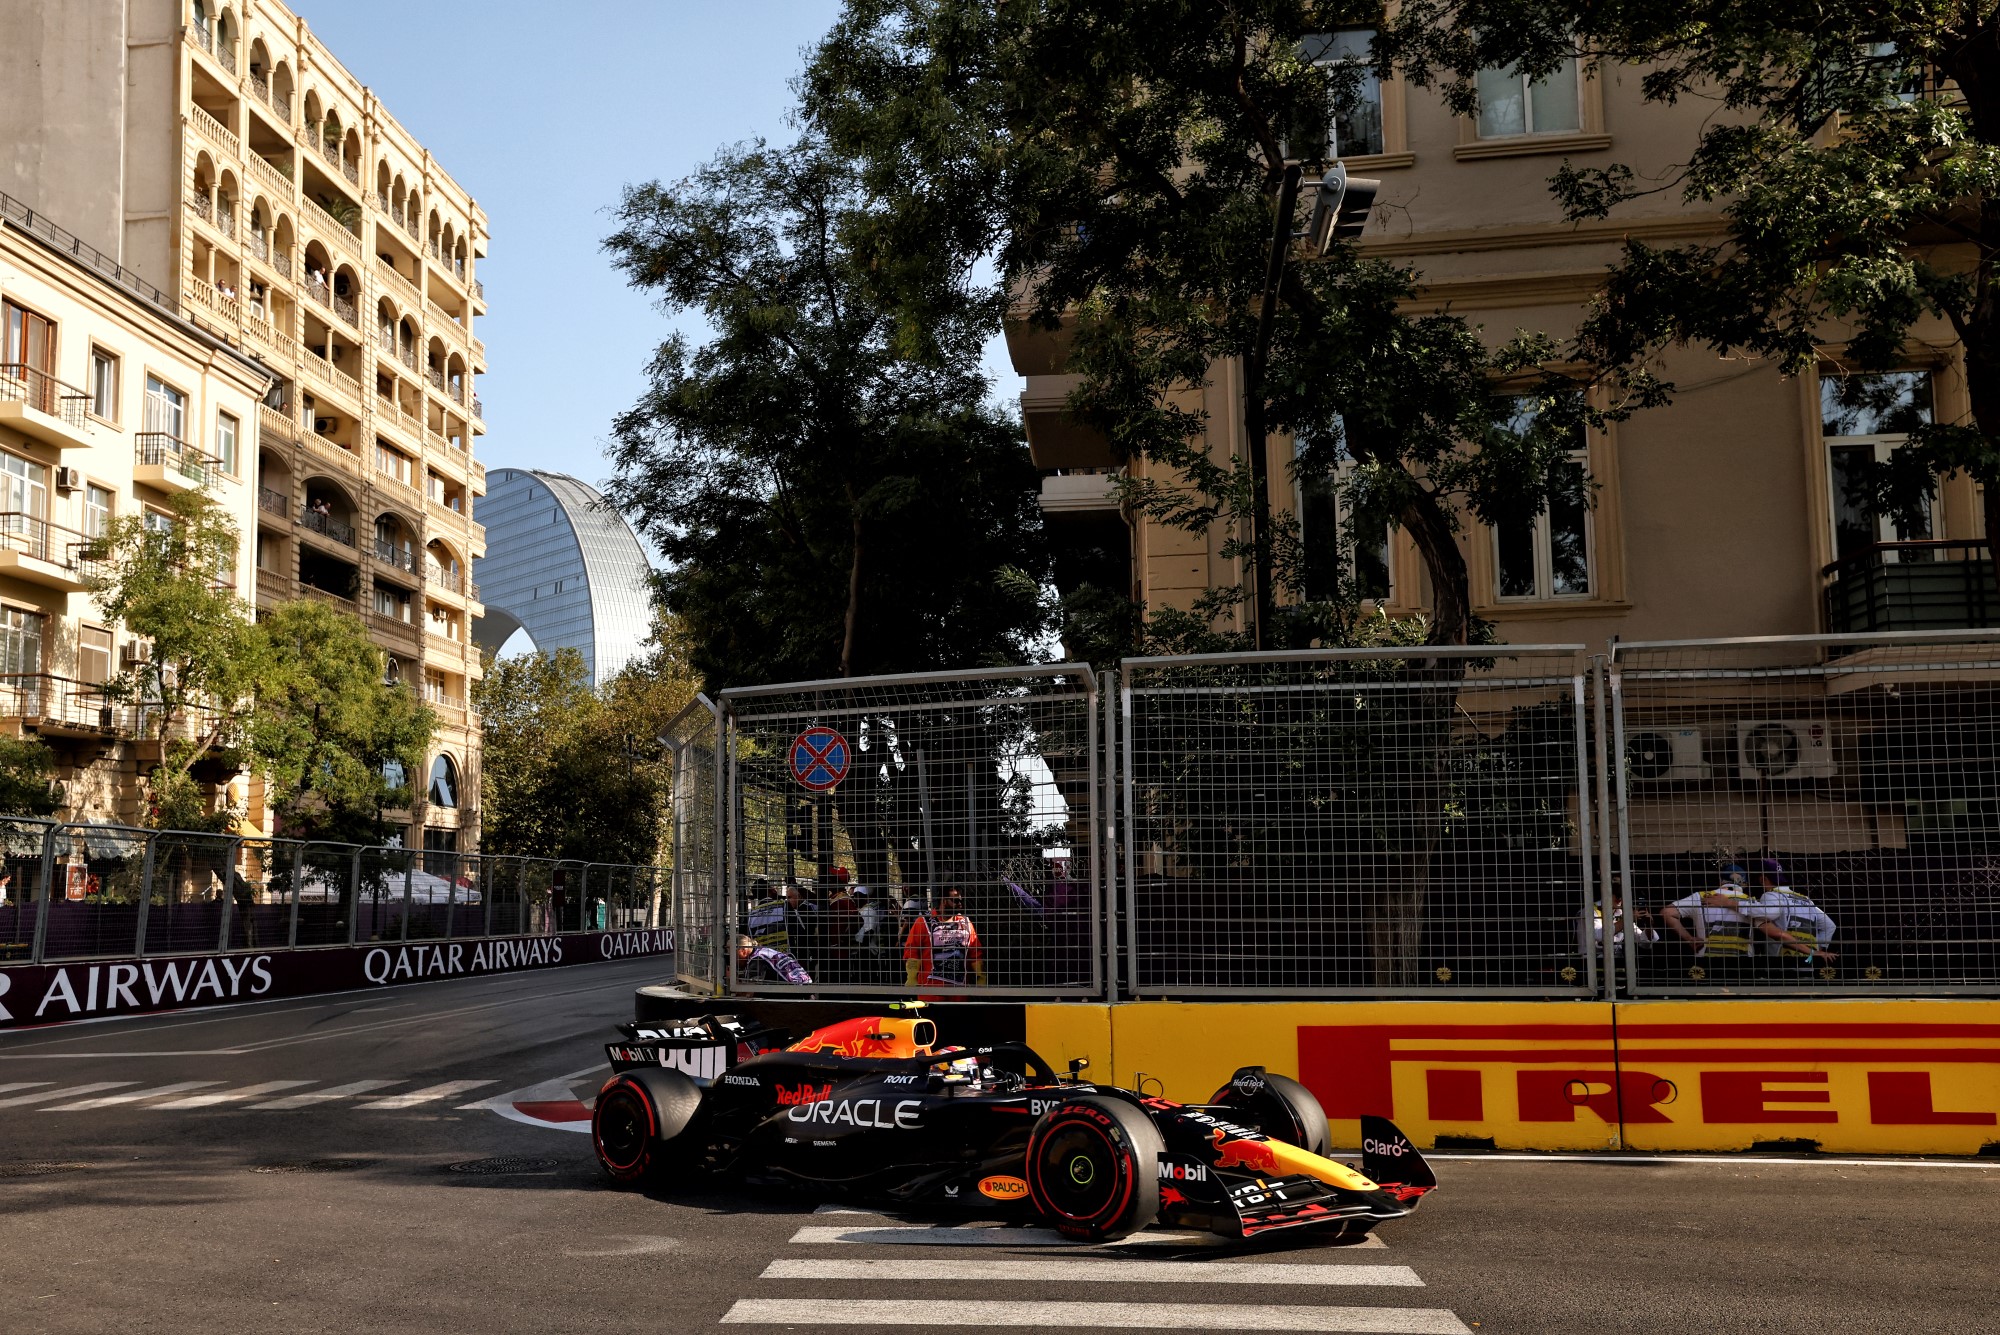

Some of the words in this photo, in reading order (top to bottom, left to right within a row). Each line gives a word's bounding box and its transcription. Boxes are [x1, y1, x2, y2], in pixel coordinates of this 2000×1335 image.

[601, 931, 650, 960] QATAR
[652, 930, 675, 952] AIR
[364, 944, 464, 985] QATAR
[470, 937, 563, 972] AIRWAYS
[34, 955, 273, 1017] AIRWAYS
[609, 1046, 646, 1062] Mobil
[724, 1075, 761, 1086] HONDA
[883, 1075, 918, 1084] ROKT
[1232, 1079, 1248, 1087] Hard
[1249, 1079, 1265, 1088] Rock
[775, 1083, 800, 1105] Red
[800, 1084, 833, 1105] Bull
[788, 1099, 925, 1130] ORACLE
[1061, 1105, 1111, 1126] ZERO
[1364, 1138, 1403, 1157] Claro
[1158, 1161, 1206, 1182] Mobil
[992, 1181, 1025, 1193] RAUCH
